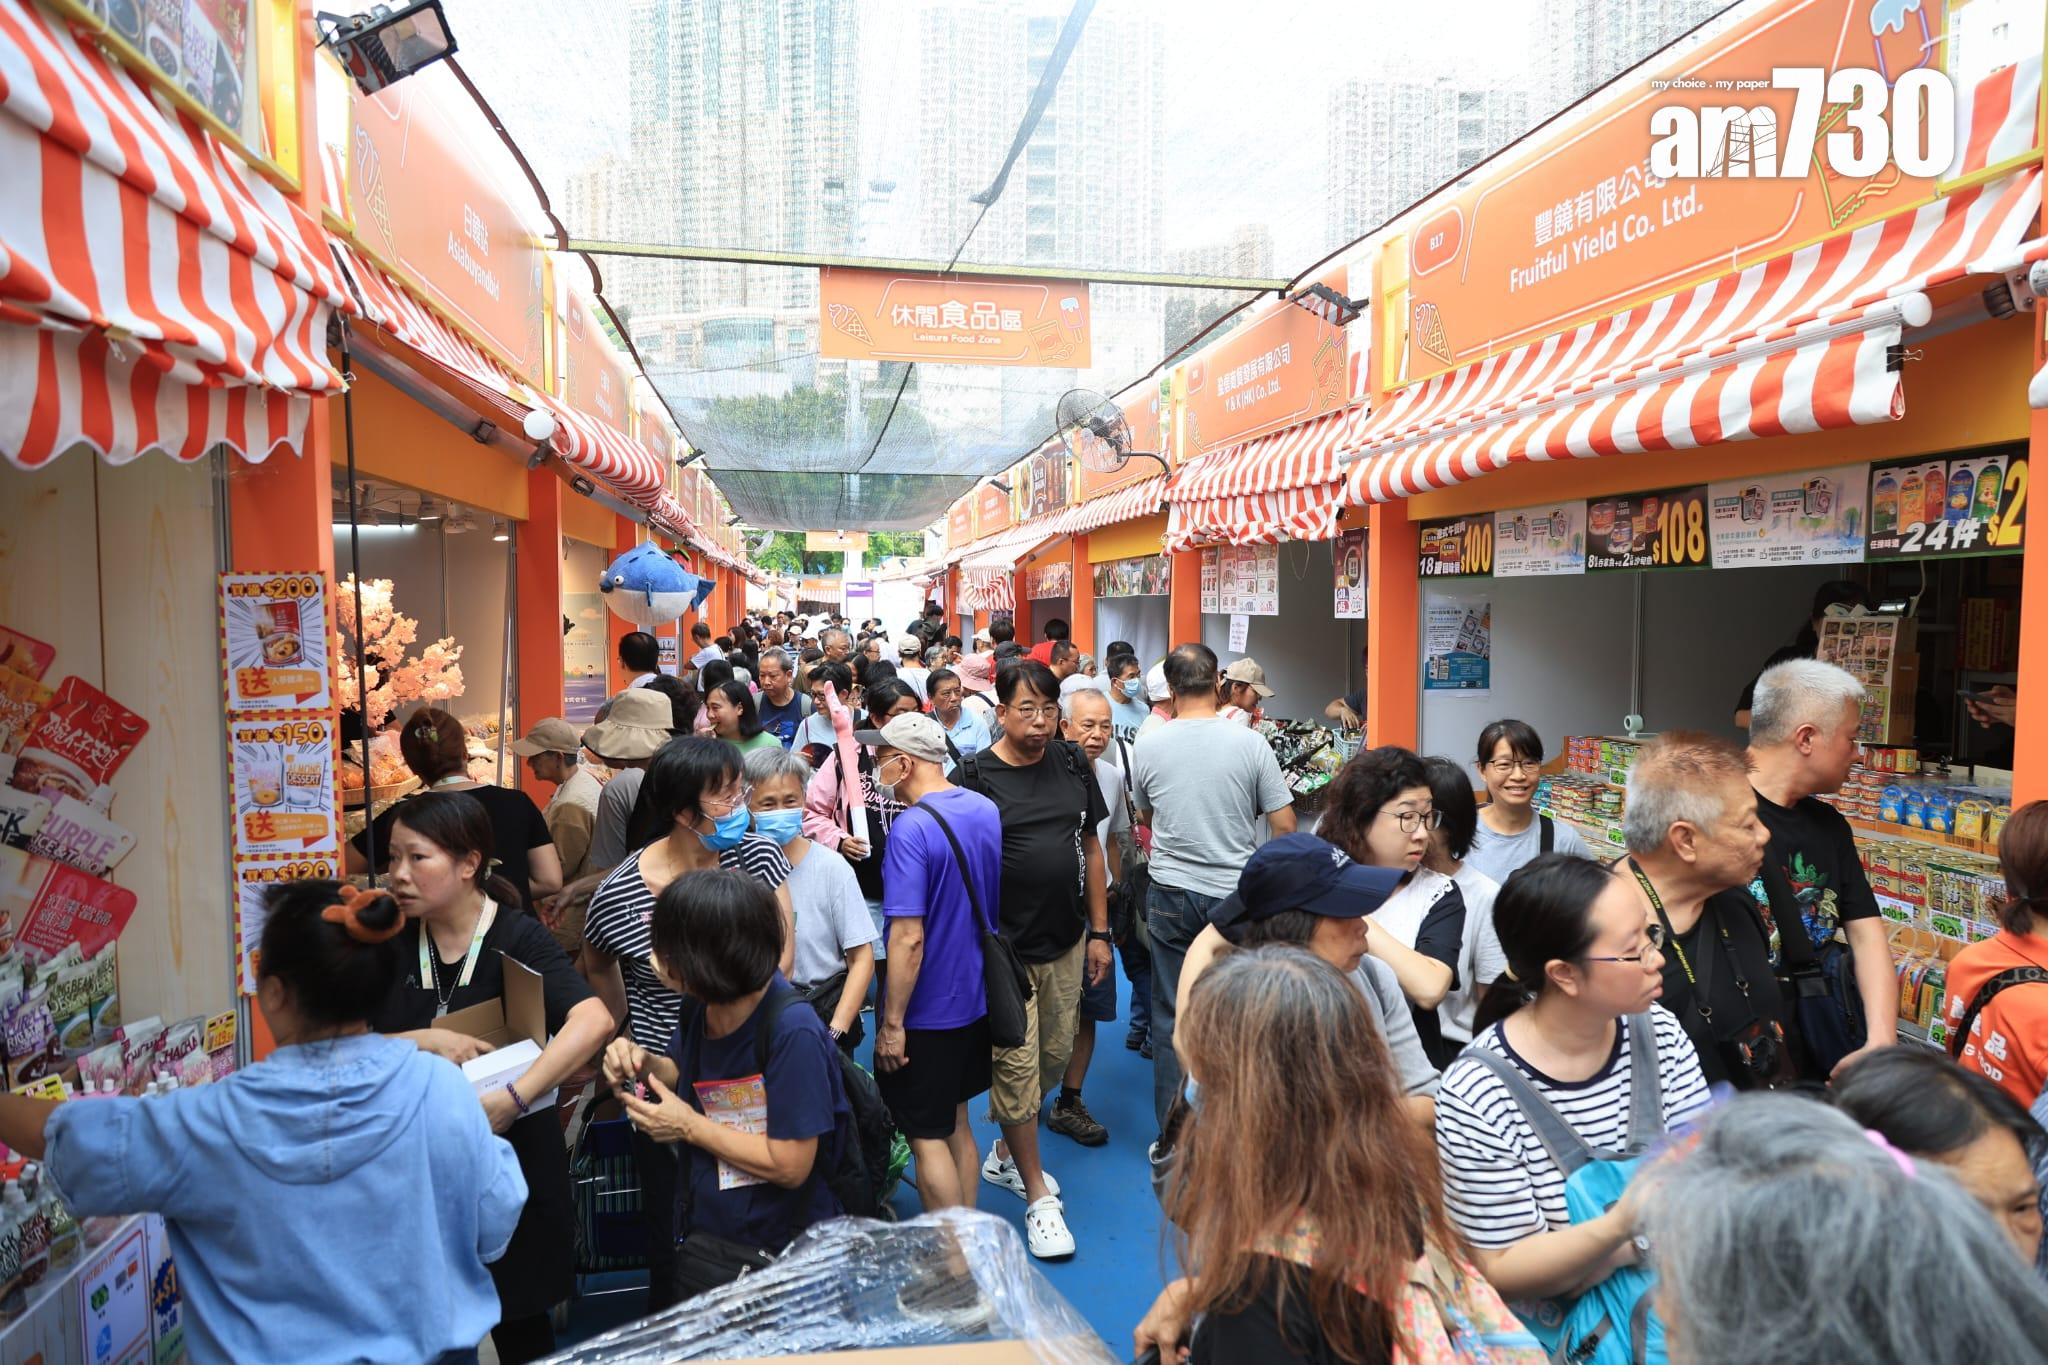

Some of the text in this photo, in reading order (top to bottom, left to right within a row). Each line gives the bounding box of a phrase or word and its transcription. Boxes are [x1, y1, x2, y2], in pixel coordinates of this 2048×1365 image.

[1510, 183, 1704, 293] Fruitful Yield Co. Ltd.
[890, 300, 1023, 332] 休閒食品區
[913, 333, 1002, 345] Leisure Food Zone
[1653, 499, 1705, 564] $108
[263, 577, 316, 599] $200
[239, 666, 271, 697] 送
[271, 722, 326, 745] $150
[245, 810, 277, 841] 送
